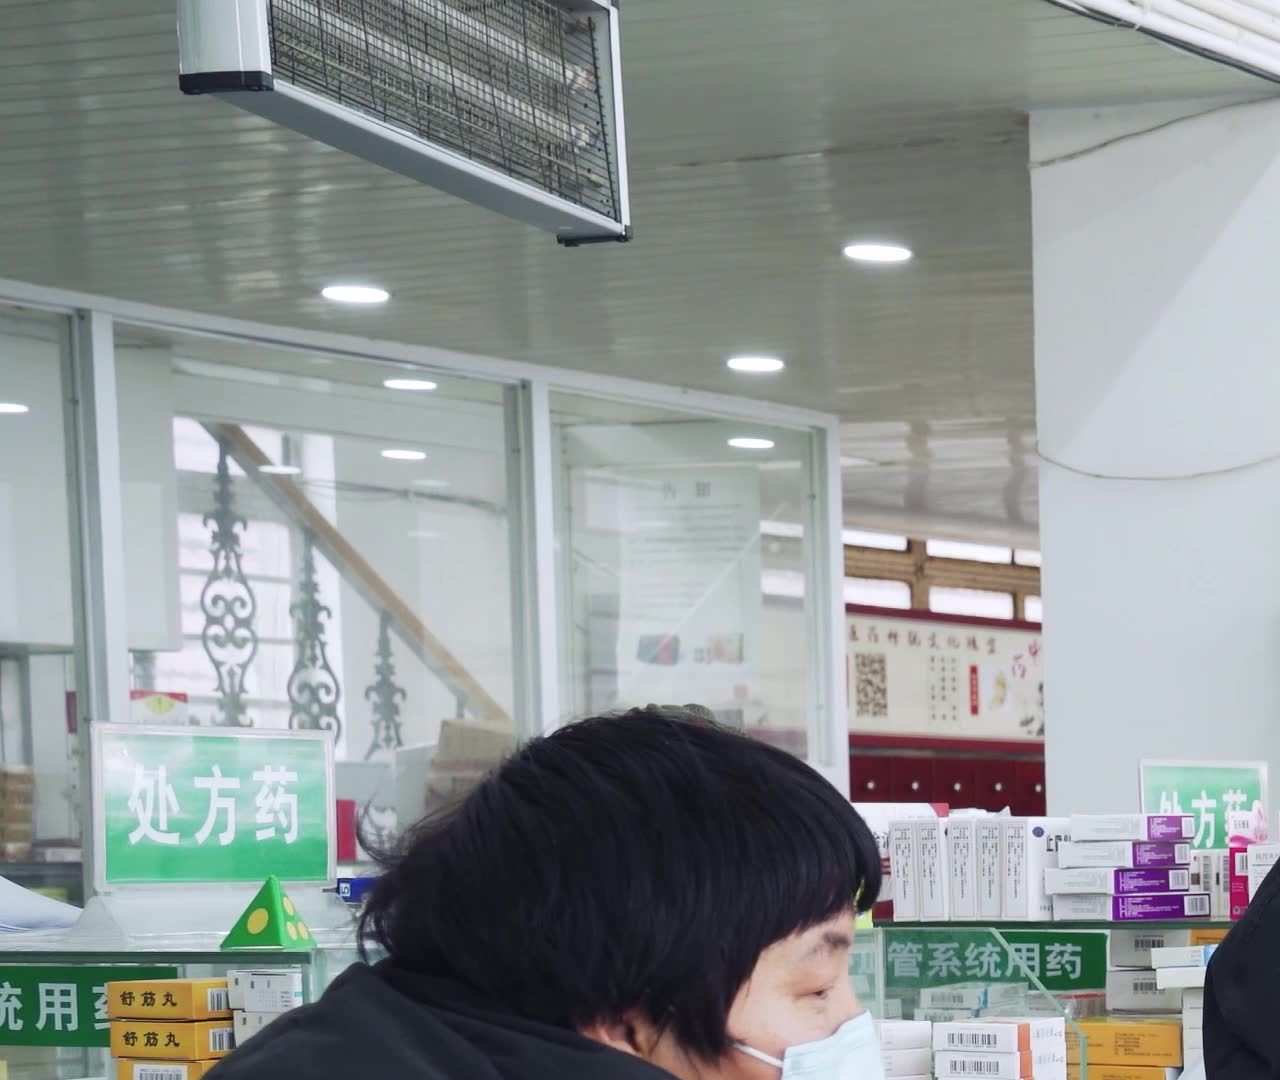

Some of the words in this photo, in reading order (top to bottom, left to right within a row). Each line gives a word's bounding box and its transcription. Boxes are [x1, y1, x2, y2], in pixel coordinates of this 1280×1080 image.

[127, 764, 298, 846] 处方药
[120, 991, 178, 1008] 舒筋丸
[123, 1031, 181, 1048] 舒筋丸
